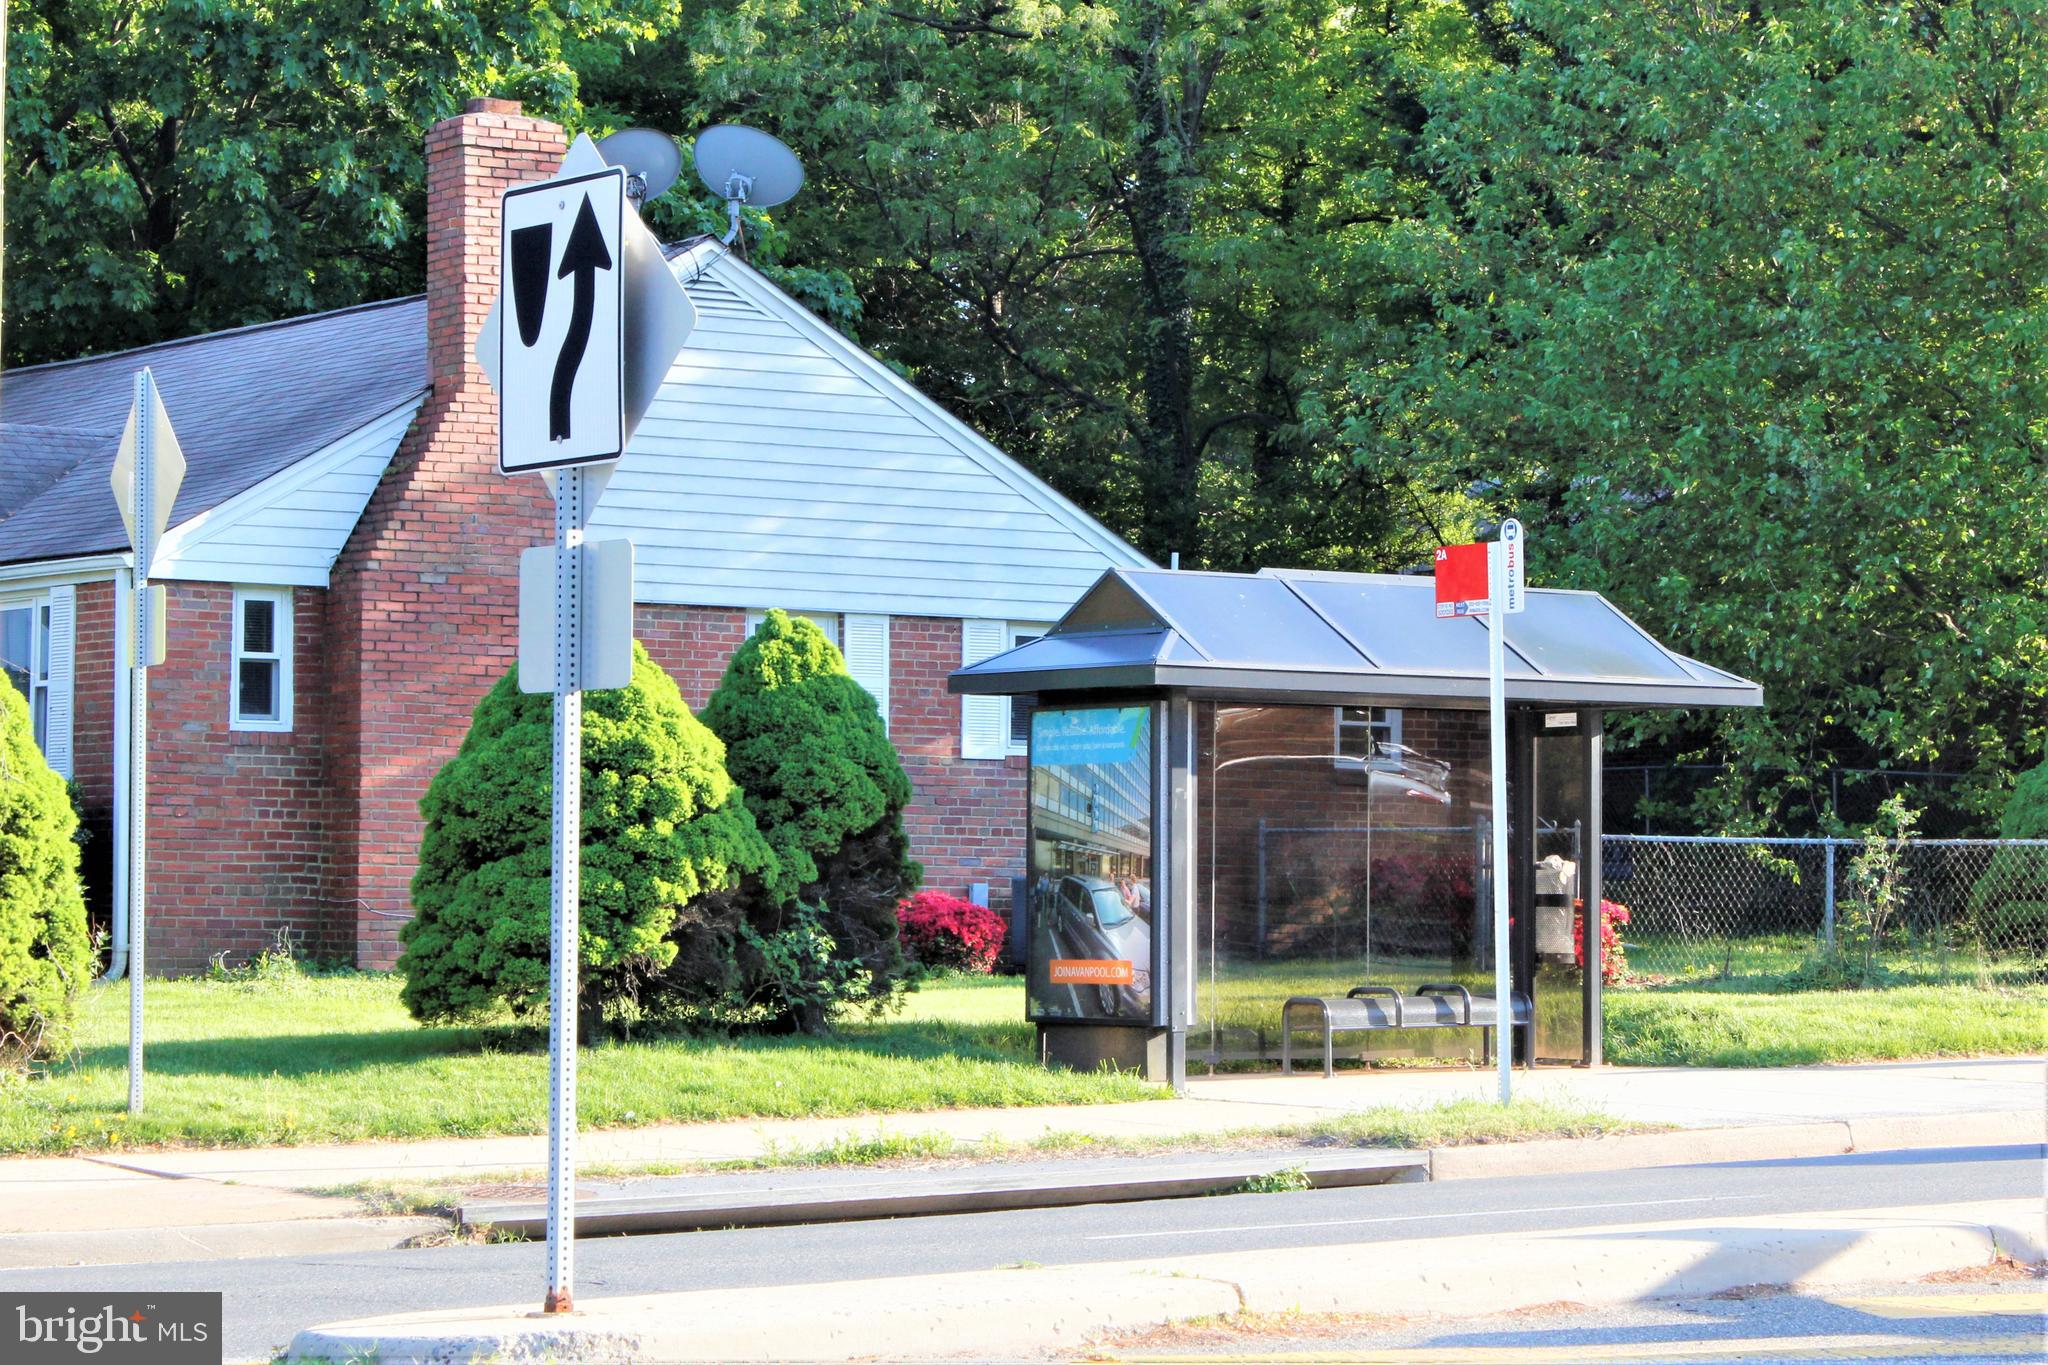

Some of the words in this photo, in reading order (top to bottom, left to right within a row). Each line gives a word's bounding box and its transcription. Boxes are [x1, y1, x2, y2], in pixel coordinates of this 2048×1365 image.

[1436, 549, 1447, 561] 2A
[1507, 543, 1515, 610] metrobus
[1054, 966, 1129, 978] JOINAVANPOOL.COM
